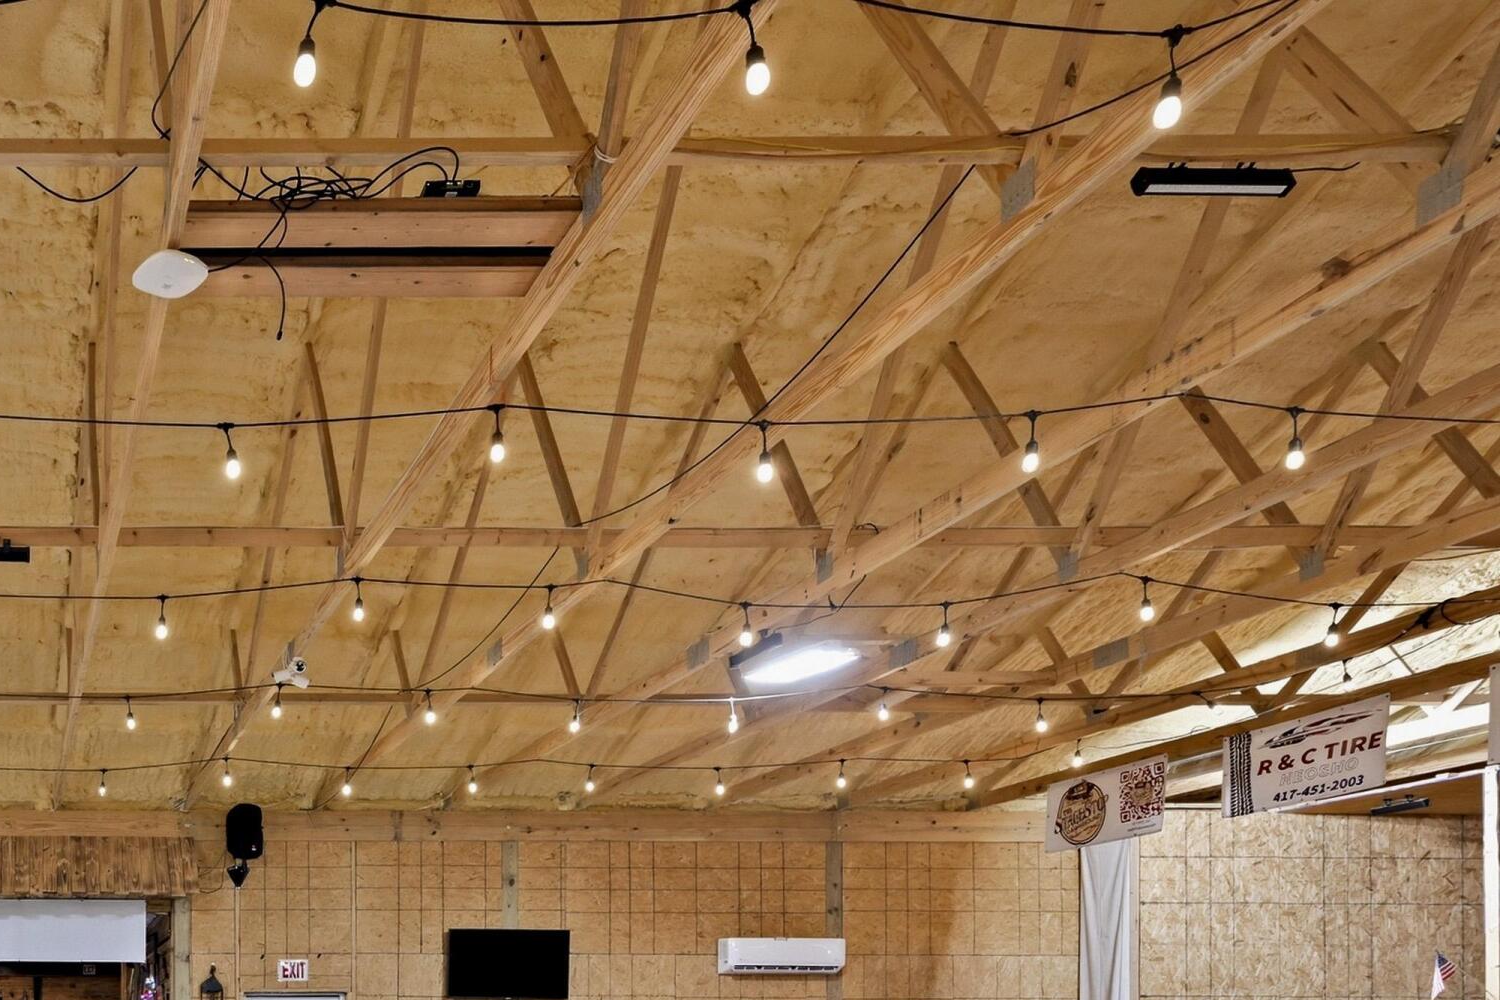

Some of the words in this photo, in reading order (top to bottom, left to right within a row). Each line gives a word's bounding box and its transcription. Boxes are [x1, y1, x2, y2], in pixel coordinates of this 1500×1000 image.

[1257, 759, 1273, 776] R
[1277, 754, 1295, 771] &
[1301, 748, 1318, 764] C
[1324, 730, 1384, 760] TIRE
[1272, 774, 1365, 803] 417-451-2003
[282, 961, 307, 979] EXIT
